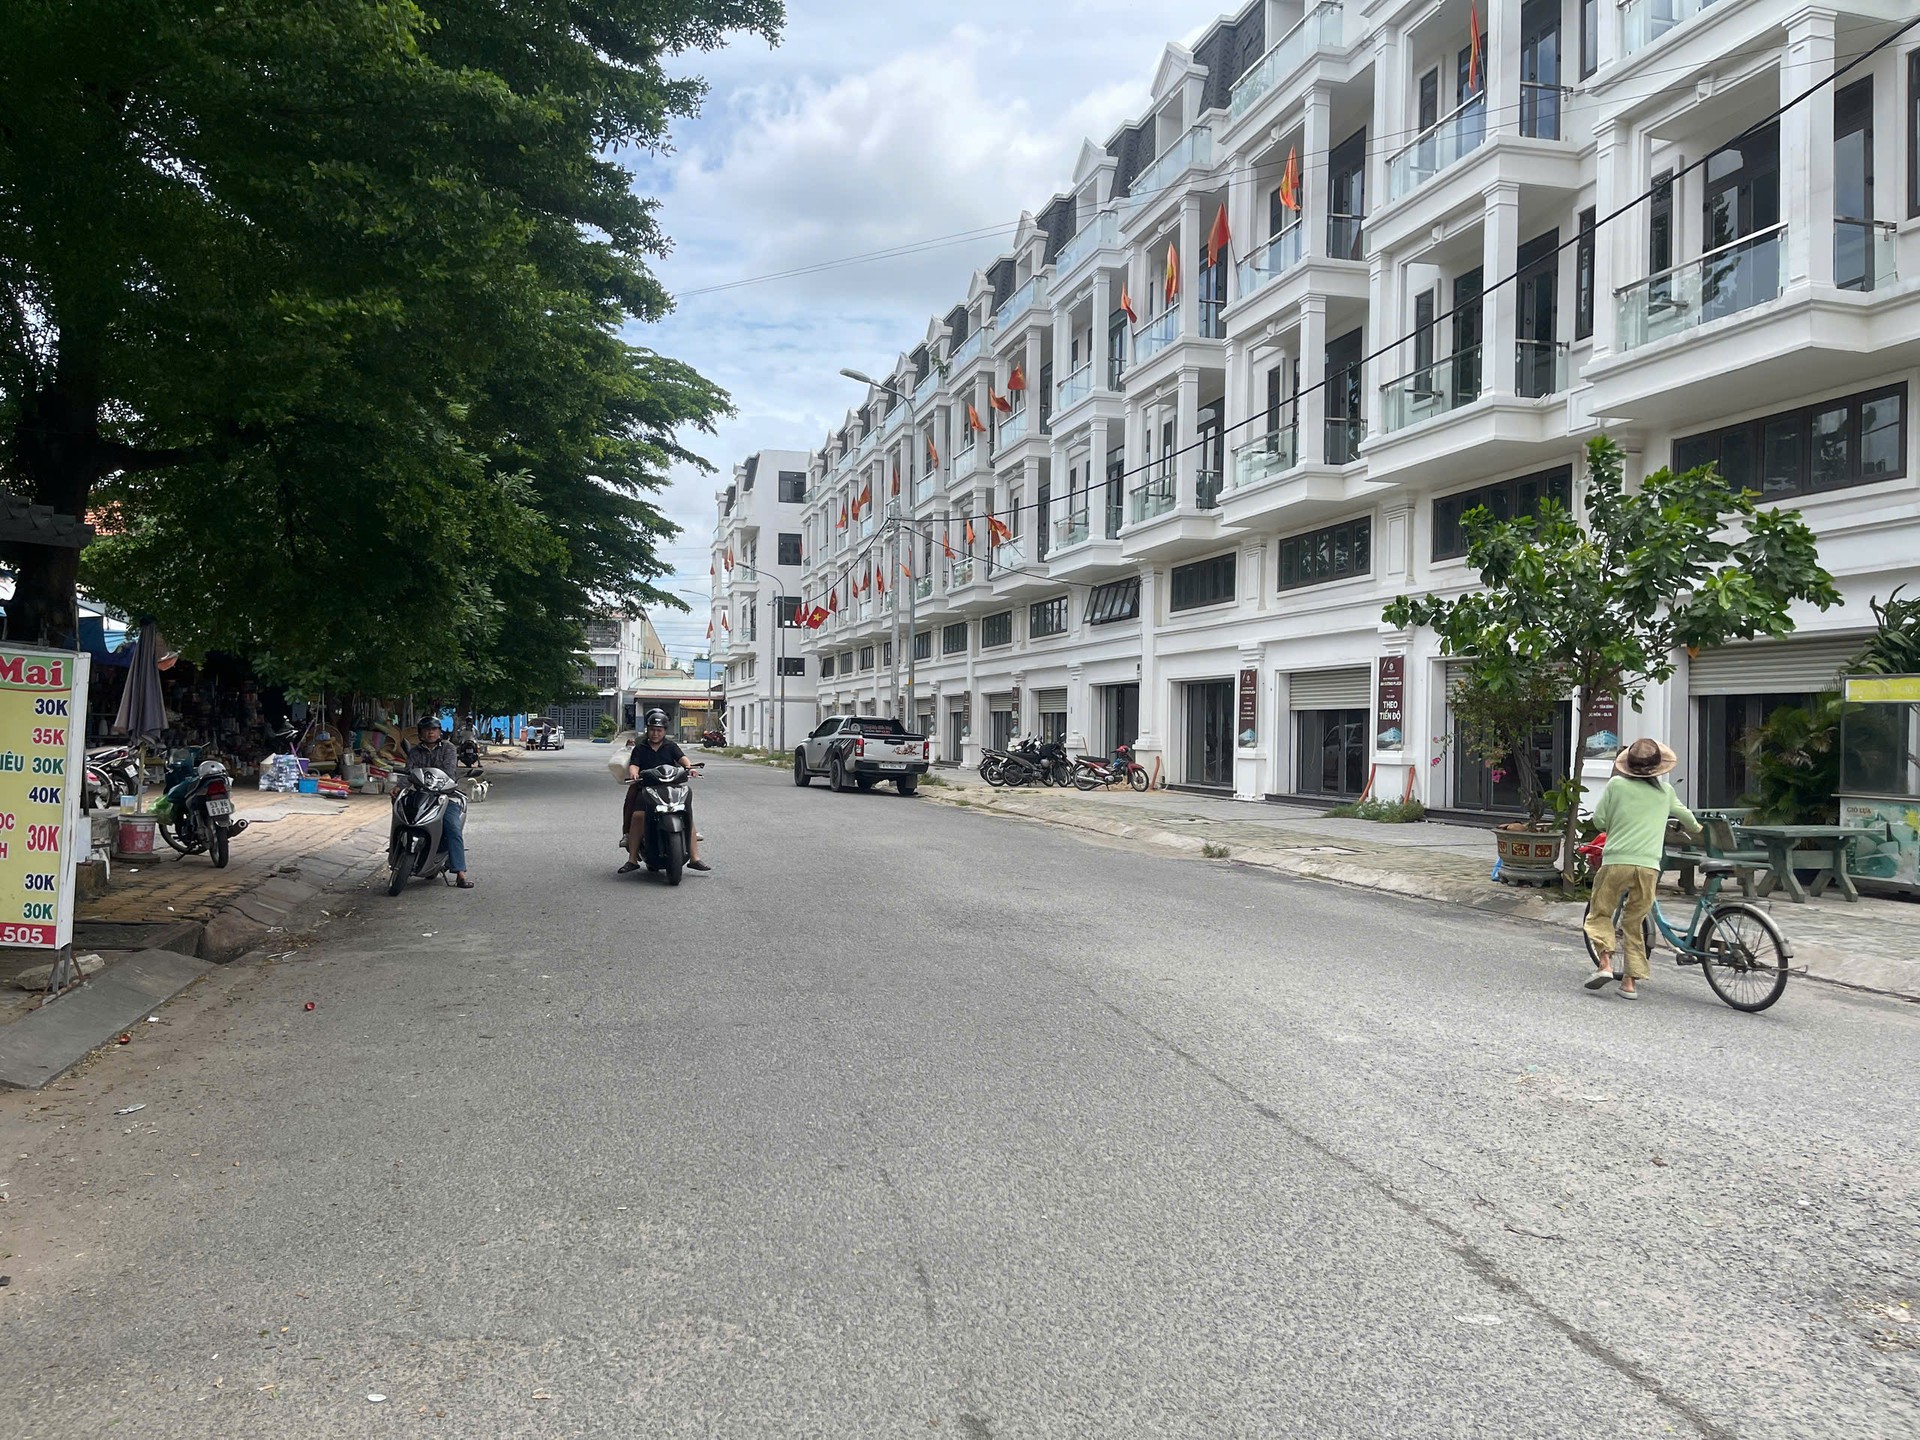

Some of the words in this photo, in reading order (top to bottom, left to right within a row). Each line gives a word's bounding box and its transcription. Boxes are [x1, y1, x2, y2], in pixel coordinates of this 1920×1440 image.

[0, 655, 63, 686] Mai
[34, 698, 68, 716] 30K
[1383, 701, 1398, 709] THEO
[1379, 709, 1391, 720] TIẾN
[1392, 710, 1401, 722] ĐỘ
[32, 728, 65, 745] 35K
[32, 757, 64, 774] 30K
[29, 786, 61, 804] 40K
[27, 824, 60, 852] 30K
[25, 873, 55, 891] 30K
[23, 903, 53, 920] 30K
